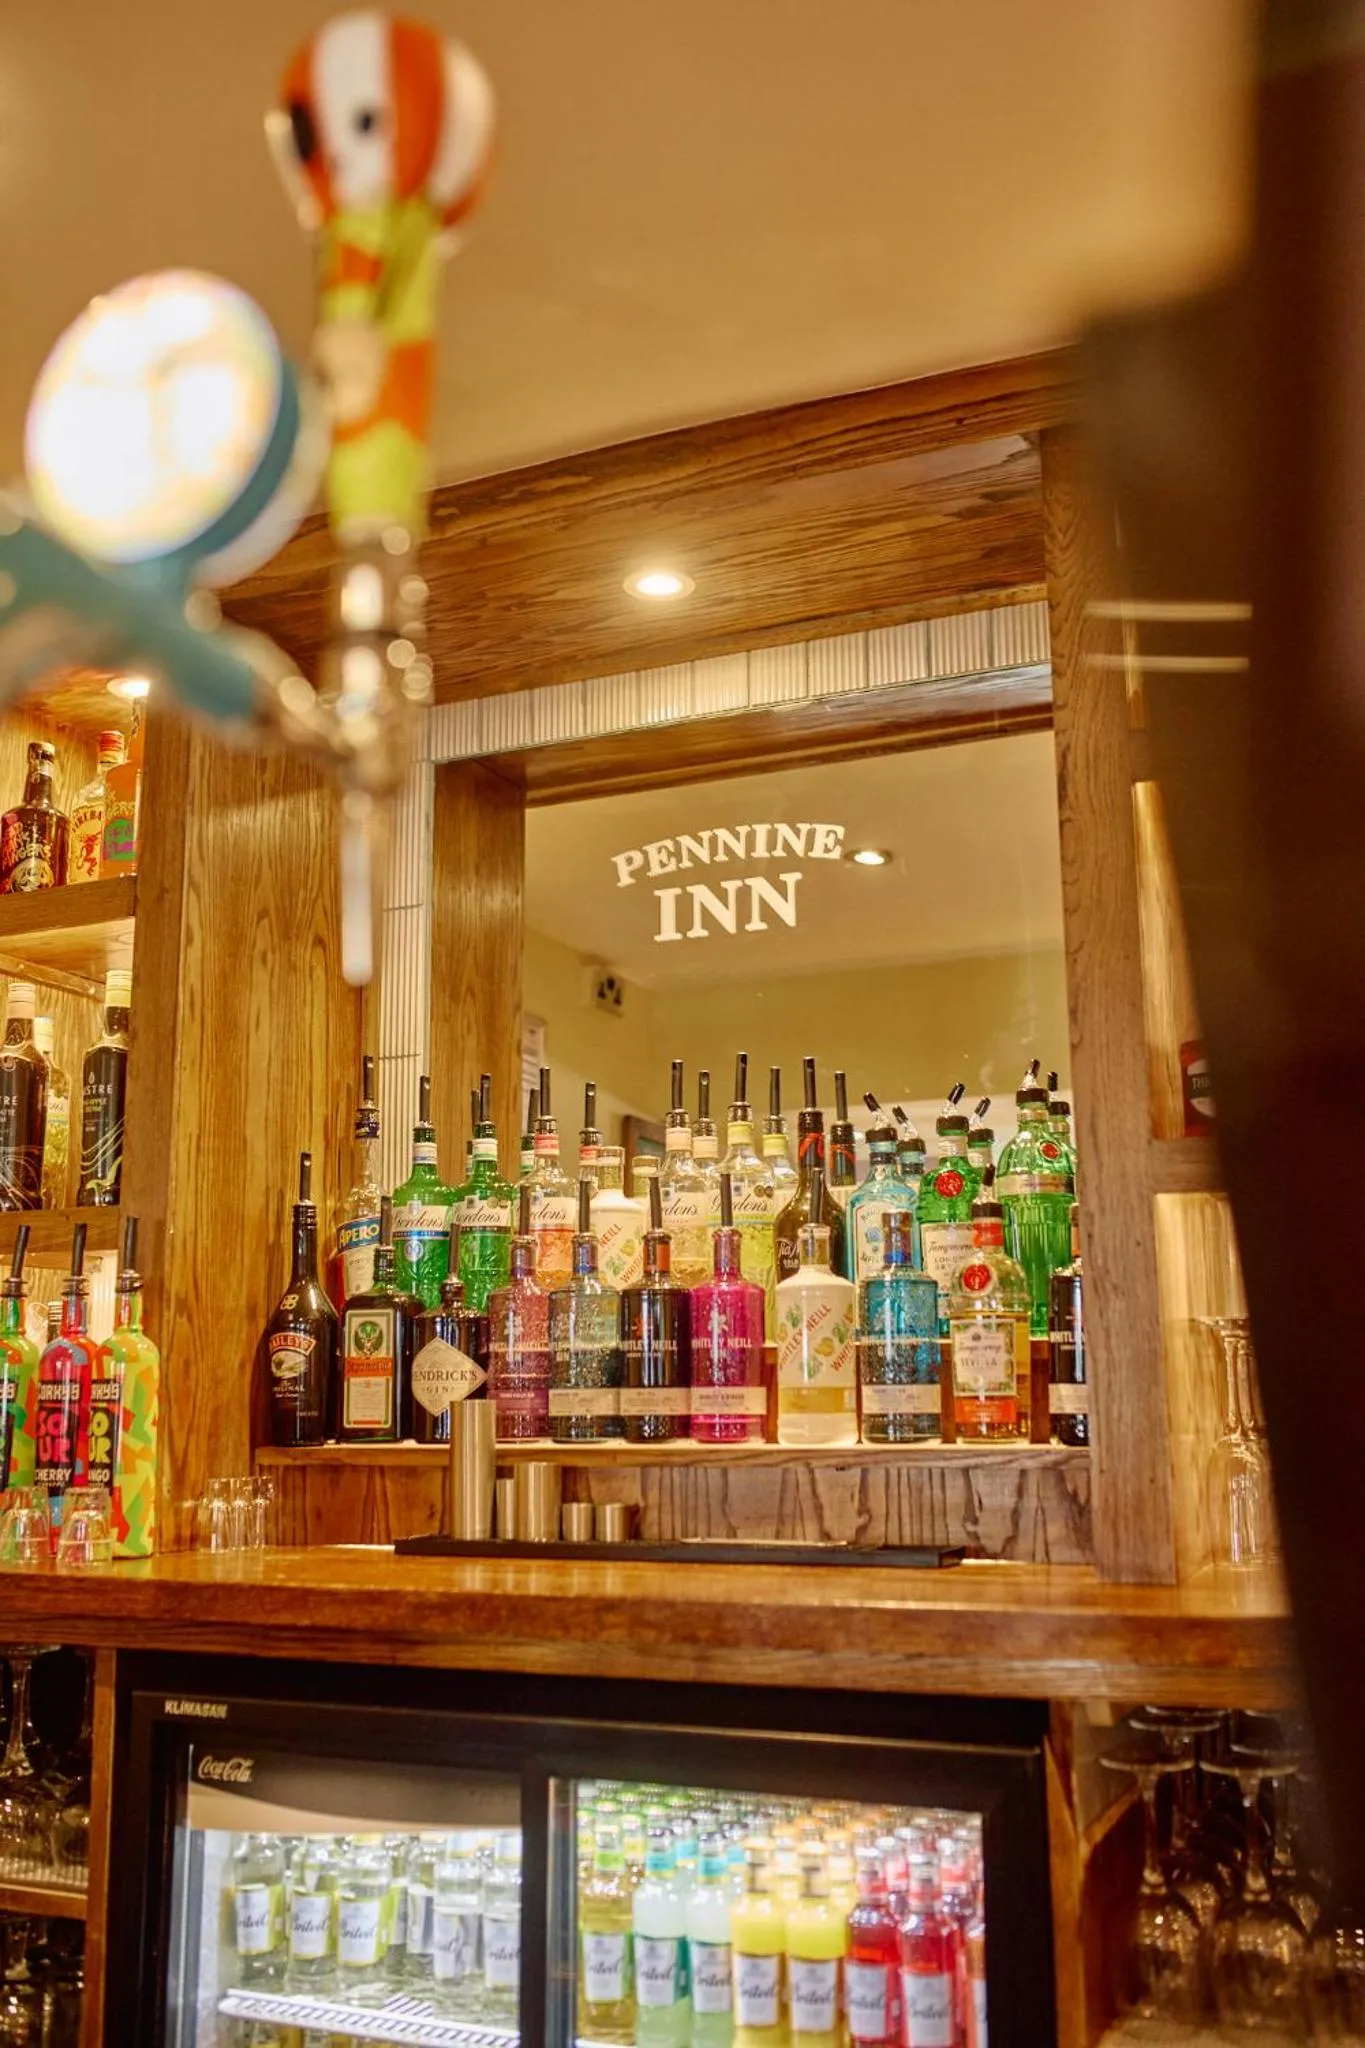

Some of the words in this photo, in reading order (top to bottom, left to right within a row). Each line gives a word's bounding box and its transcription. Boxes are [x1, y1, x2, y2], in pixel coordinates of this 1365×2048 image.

[611, 823, 845, 888] PENNINE
[653, 872, 803, 942] INN
[339, 1223, 380, 1248] APERO
[805, 1302, 832, 1333] NEILL
[414, 1369, 479, 1383] ENDRICK'S
[39, 1436, 70, 1463] UR
[198, 1755, 255, 1783] Coca-Cola
